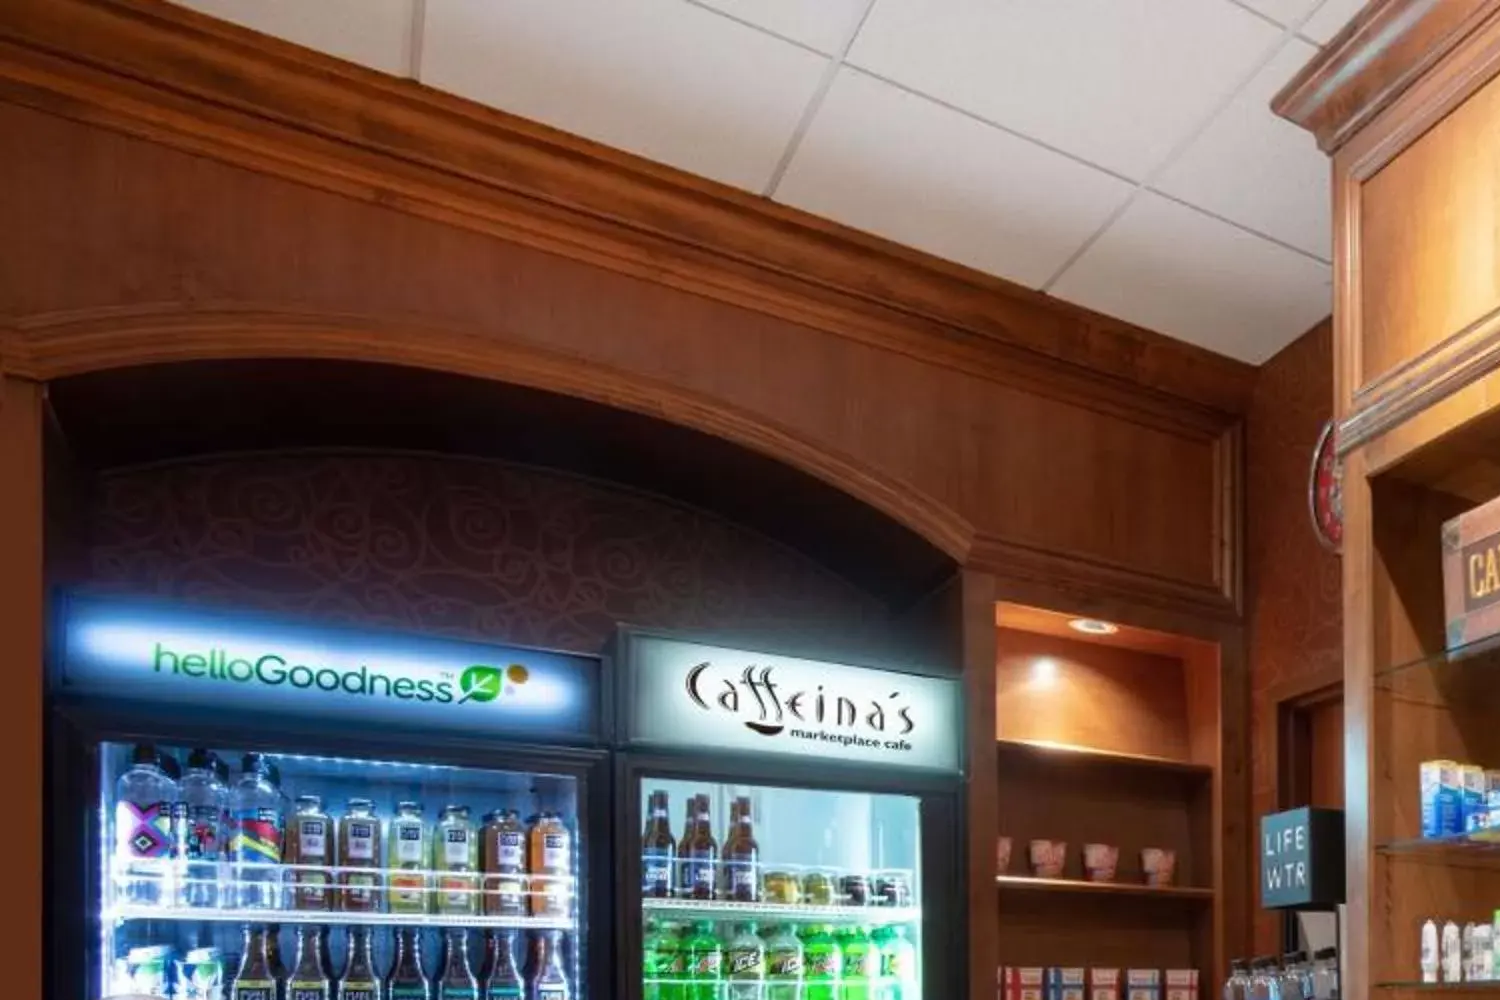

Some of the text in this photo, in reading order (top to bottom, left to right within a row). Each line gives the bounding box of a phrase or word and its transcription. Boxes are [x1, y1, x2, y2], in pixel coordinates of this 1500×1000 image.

[153, 643, 453, 704] helloGoodness
[685, 661, 916, 735] Caffeina's
[789, 727, 912, 752] marketplace cafe
[1265, 826, 1305, 856] LIFE
[1267, 862, 1306, 891] WTR
